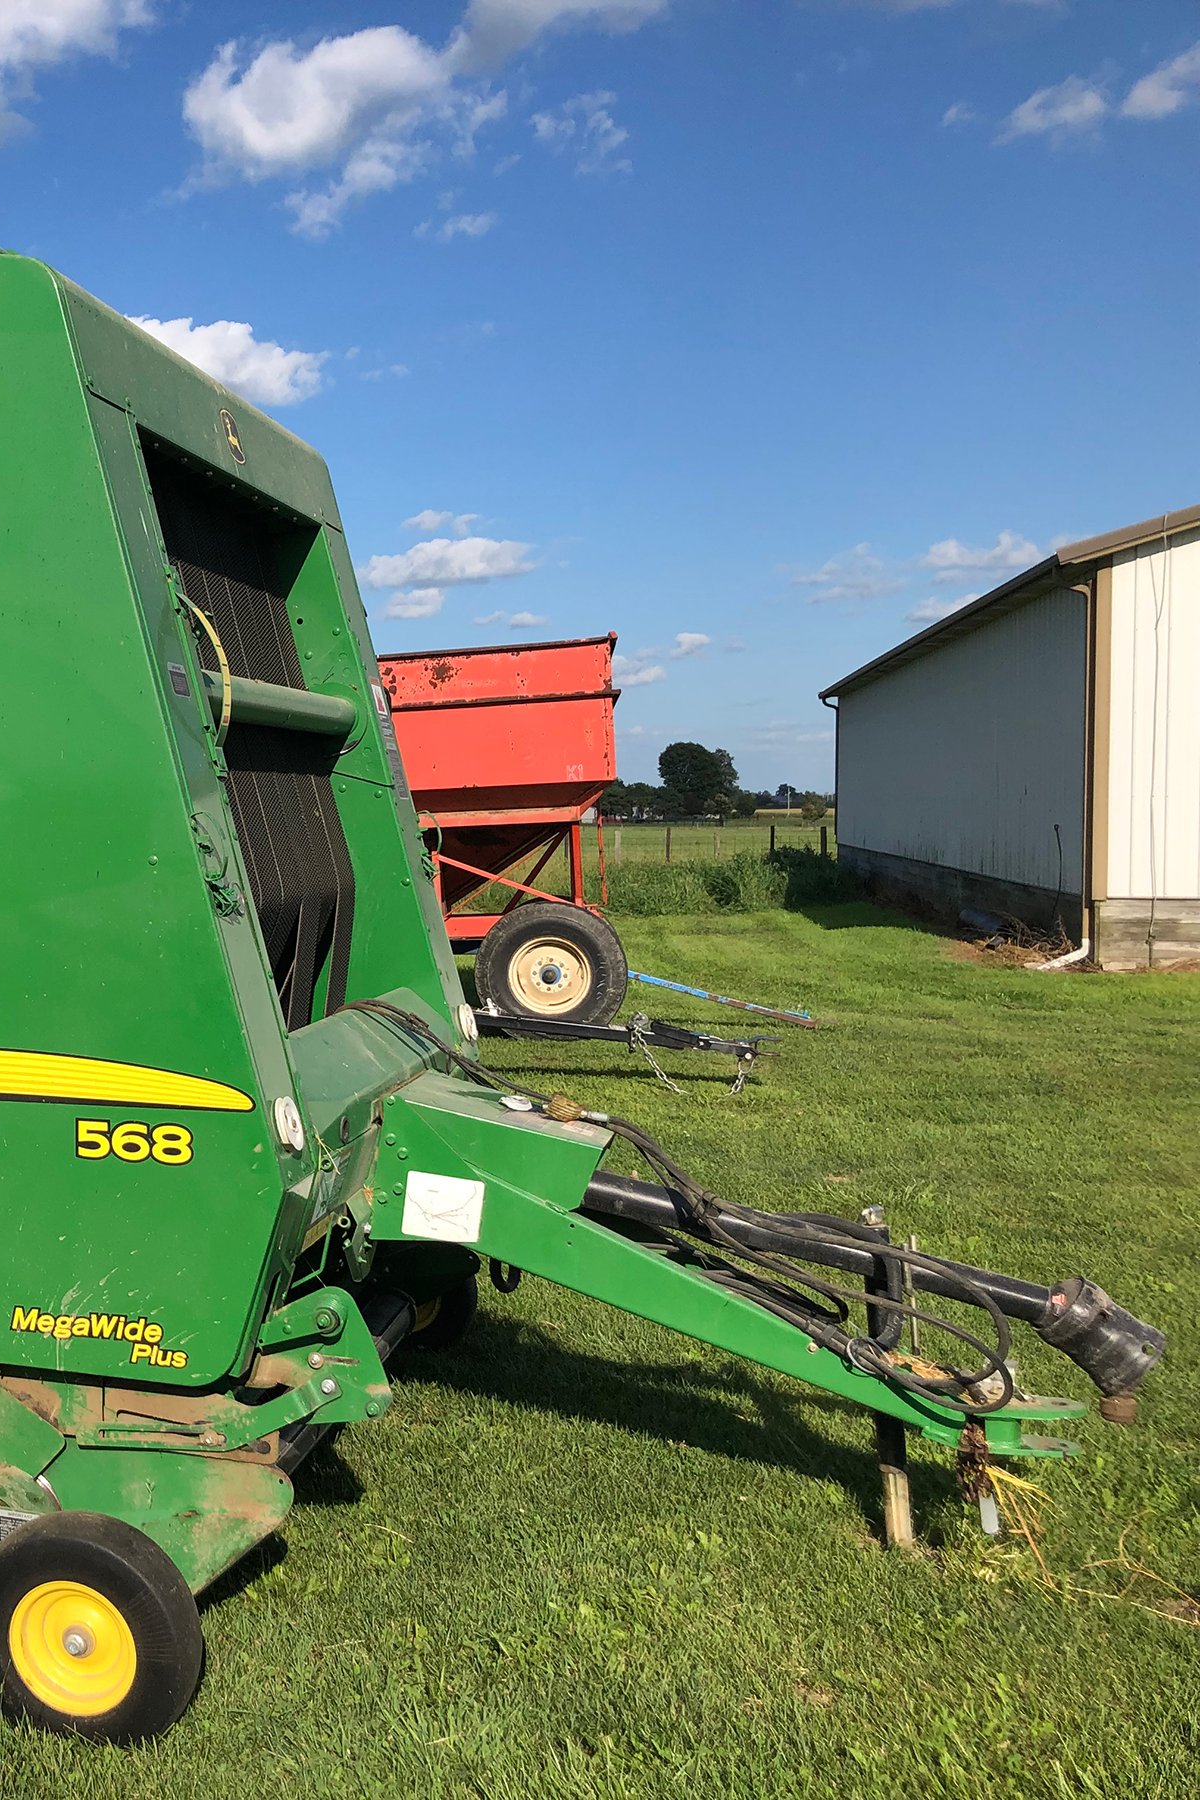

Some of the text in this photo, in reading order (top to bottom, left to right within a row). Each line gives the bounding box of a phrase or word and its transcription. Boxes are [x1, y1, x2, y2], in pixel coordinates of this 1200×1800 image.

[75, 1117, 194, 1166] 568
[10, 1305, 164, 1344] MegaWide
[130, 1342, 189, 1369] Plus
